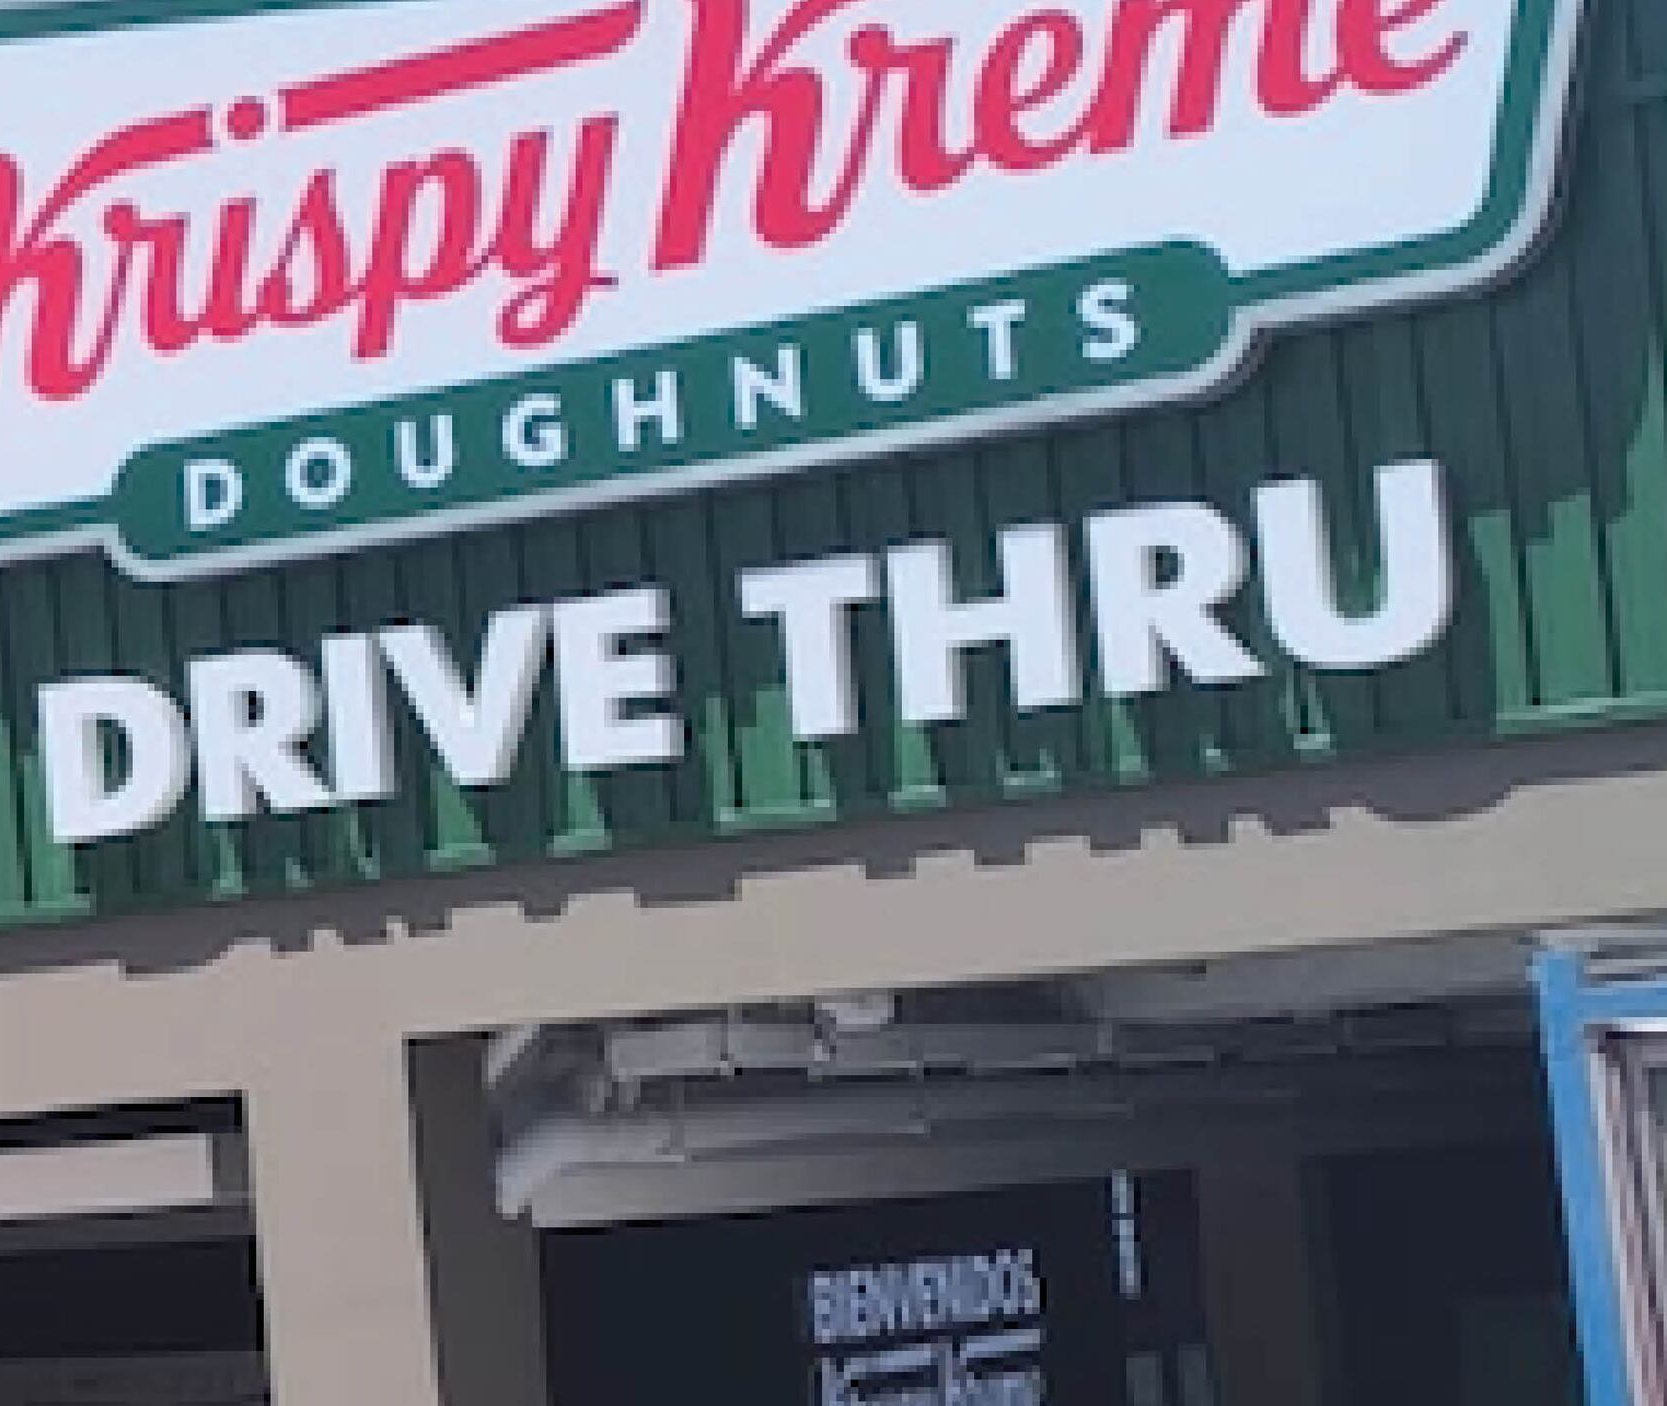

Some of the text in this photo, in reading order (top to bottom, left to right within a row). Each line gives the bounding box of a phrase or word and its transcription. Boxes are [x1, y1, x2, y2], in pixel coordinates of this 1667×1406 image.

[650, 0, 1467, 272] Kreme
[184, 283, 1138, 528] DOUGHNUTS
[37, 459, 1449, 845] DRIVE THRU
[812, 1248, 1041, 1344] BIENVENIDOS
